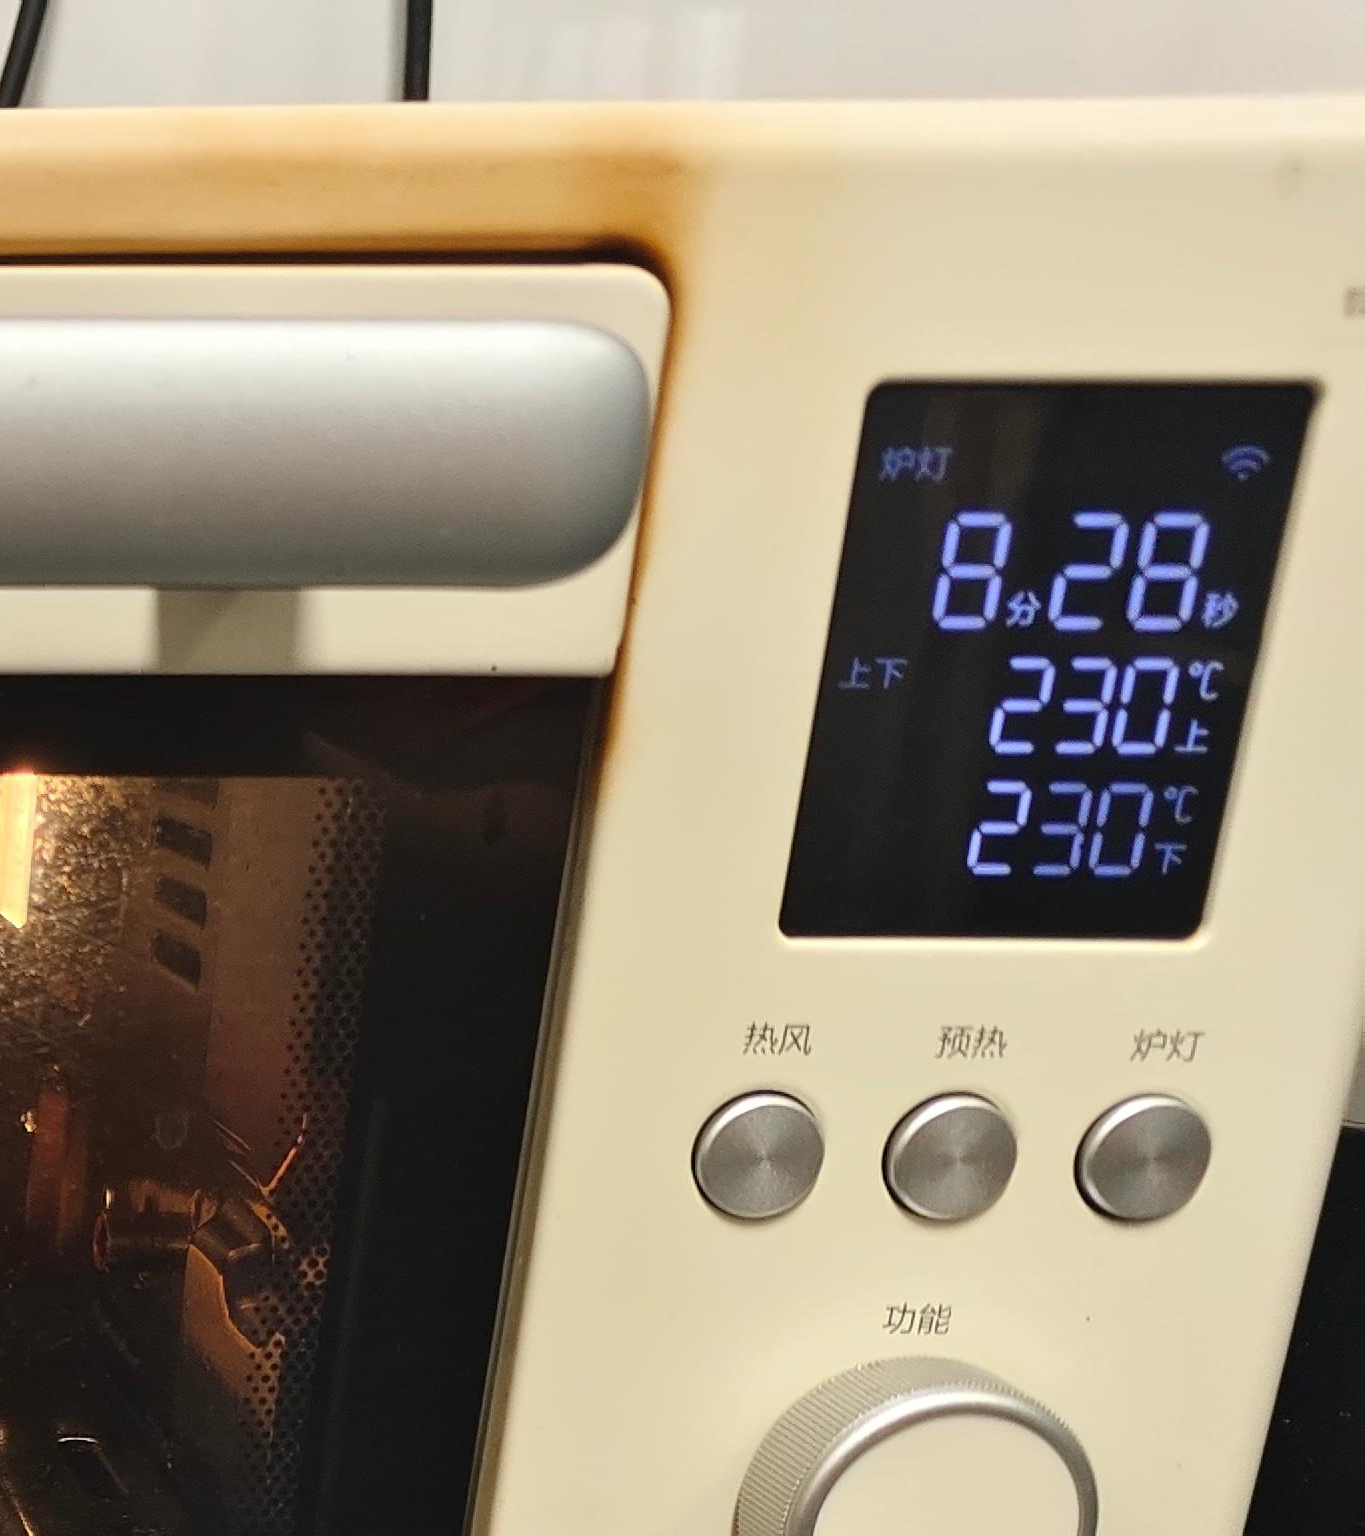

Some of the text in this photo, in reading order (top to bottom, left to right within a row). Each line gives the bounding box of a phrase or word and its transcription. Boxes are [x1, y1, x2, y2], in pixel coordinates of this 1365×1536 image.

[878, 445, 953, 482] 炉灯
[838, 656, 907, 691] 上下
[742, 1021, 812, 1056] 热风
[934, 1024, 1008, 1060] 预热
[1129, 1027, 1205, 1063] 炉灯
[882, 1303, 952, 1336] 功能
